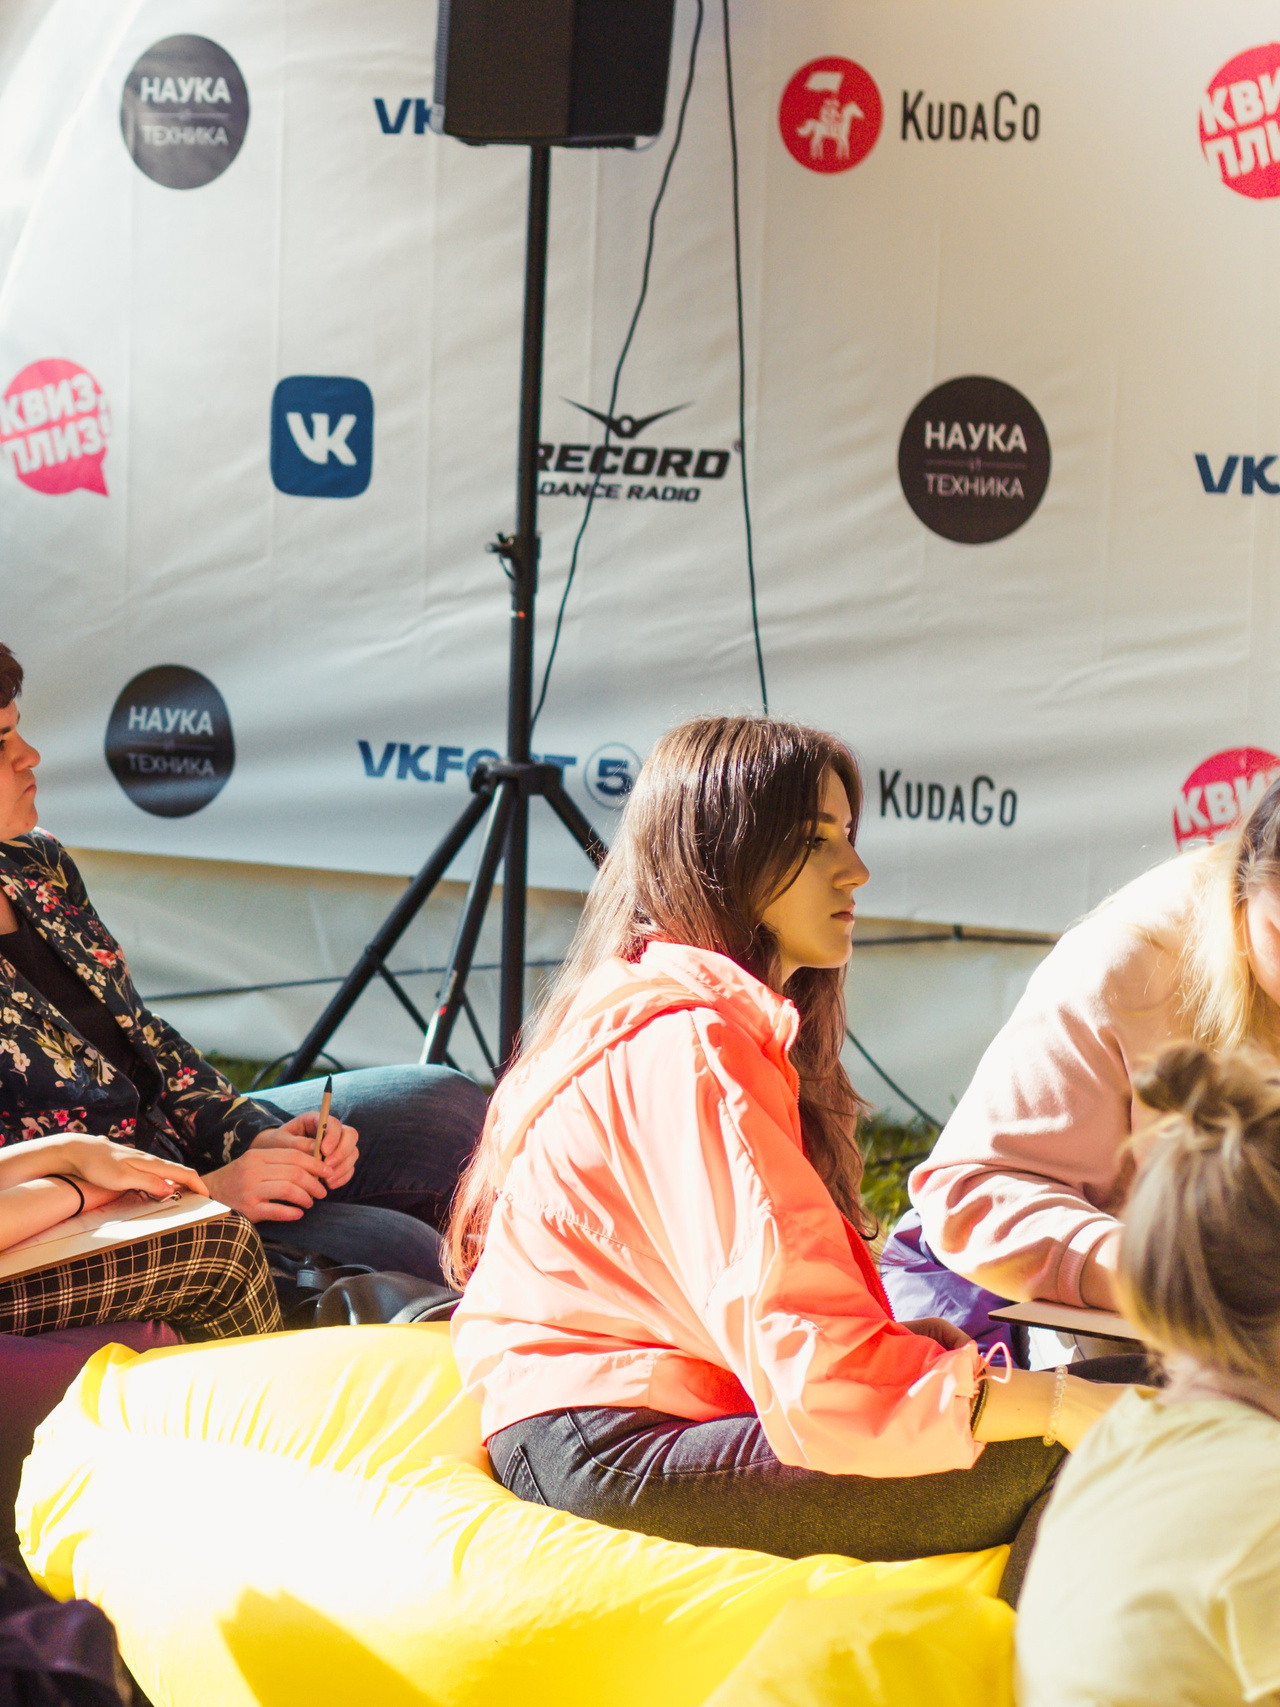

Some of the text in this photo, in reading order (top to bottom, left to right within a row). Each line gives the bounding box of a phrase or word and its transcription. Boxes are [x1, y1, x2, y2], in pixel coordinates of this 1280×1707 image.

[141, 76, 231, 104] НАУКА
[141, 125, 229, 146] ТЕХНИКА
[286, 411, 357, 466] VK
[924, 420, 1027, 453] НАУКА
[538, 482, 701, 503] DANCE RADIO
[924, 473, 1024, 500] ТЕХНИКА
[128, 705, 214, 736] НАУКА
[127, 753, 215, 776] ТЕХНИКА
[358, 740, 634, 796] VKFT 5
